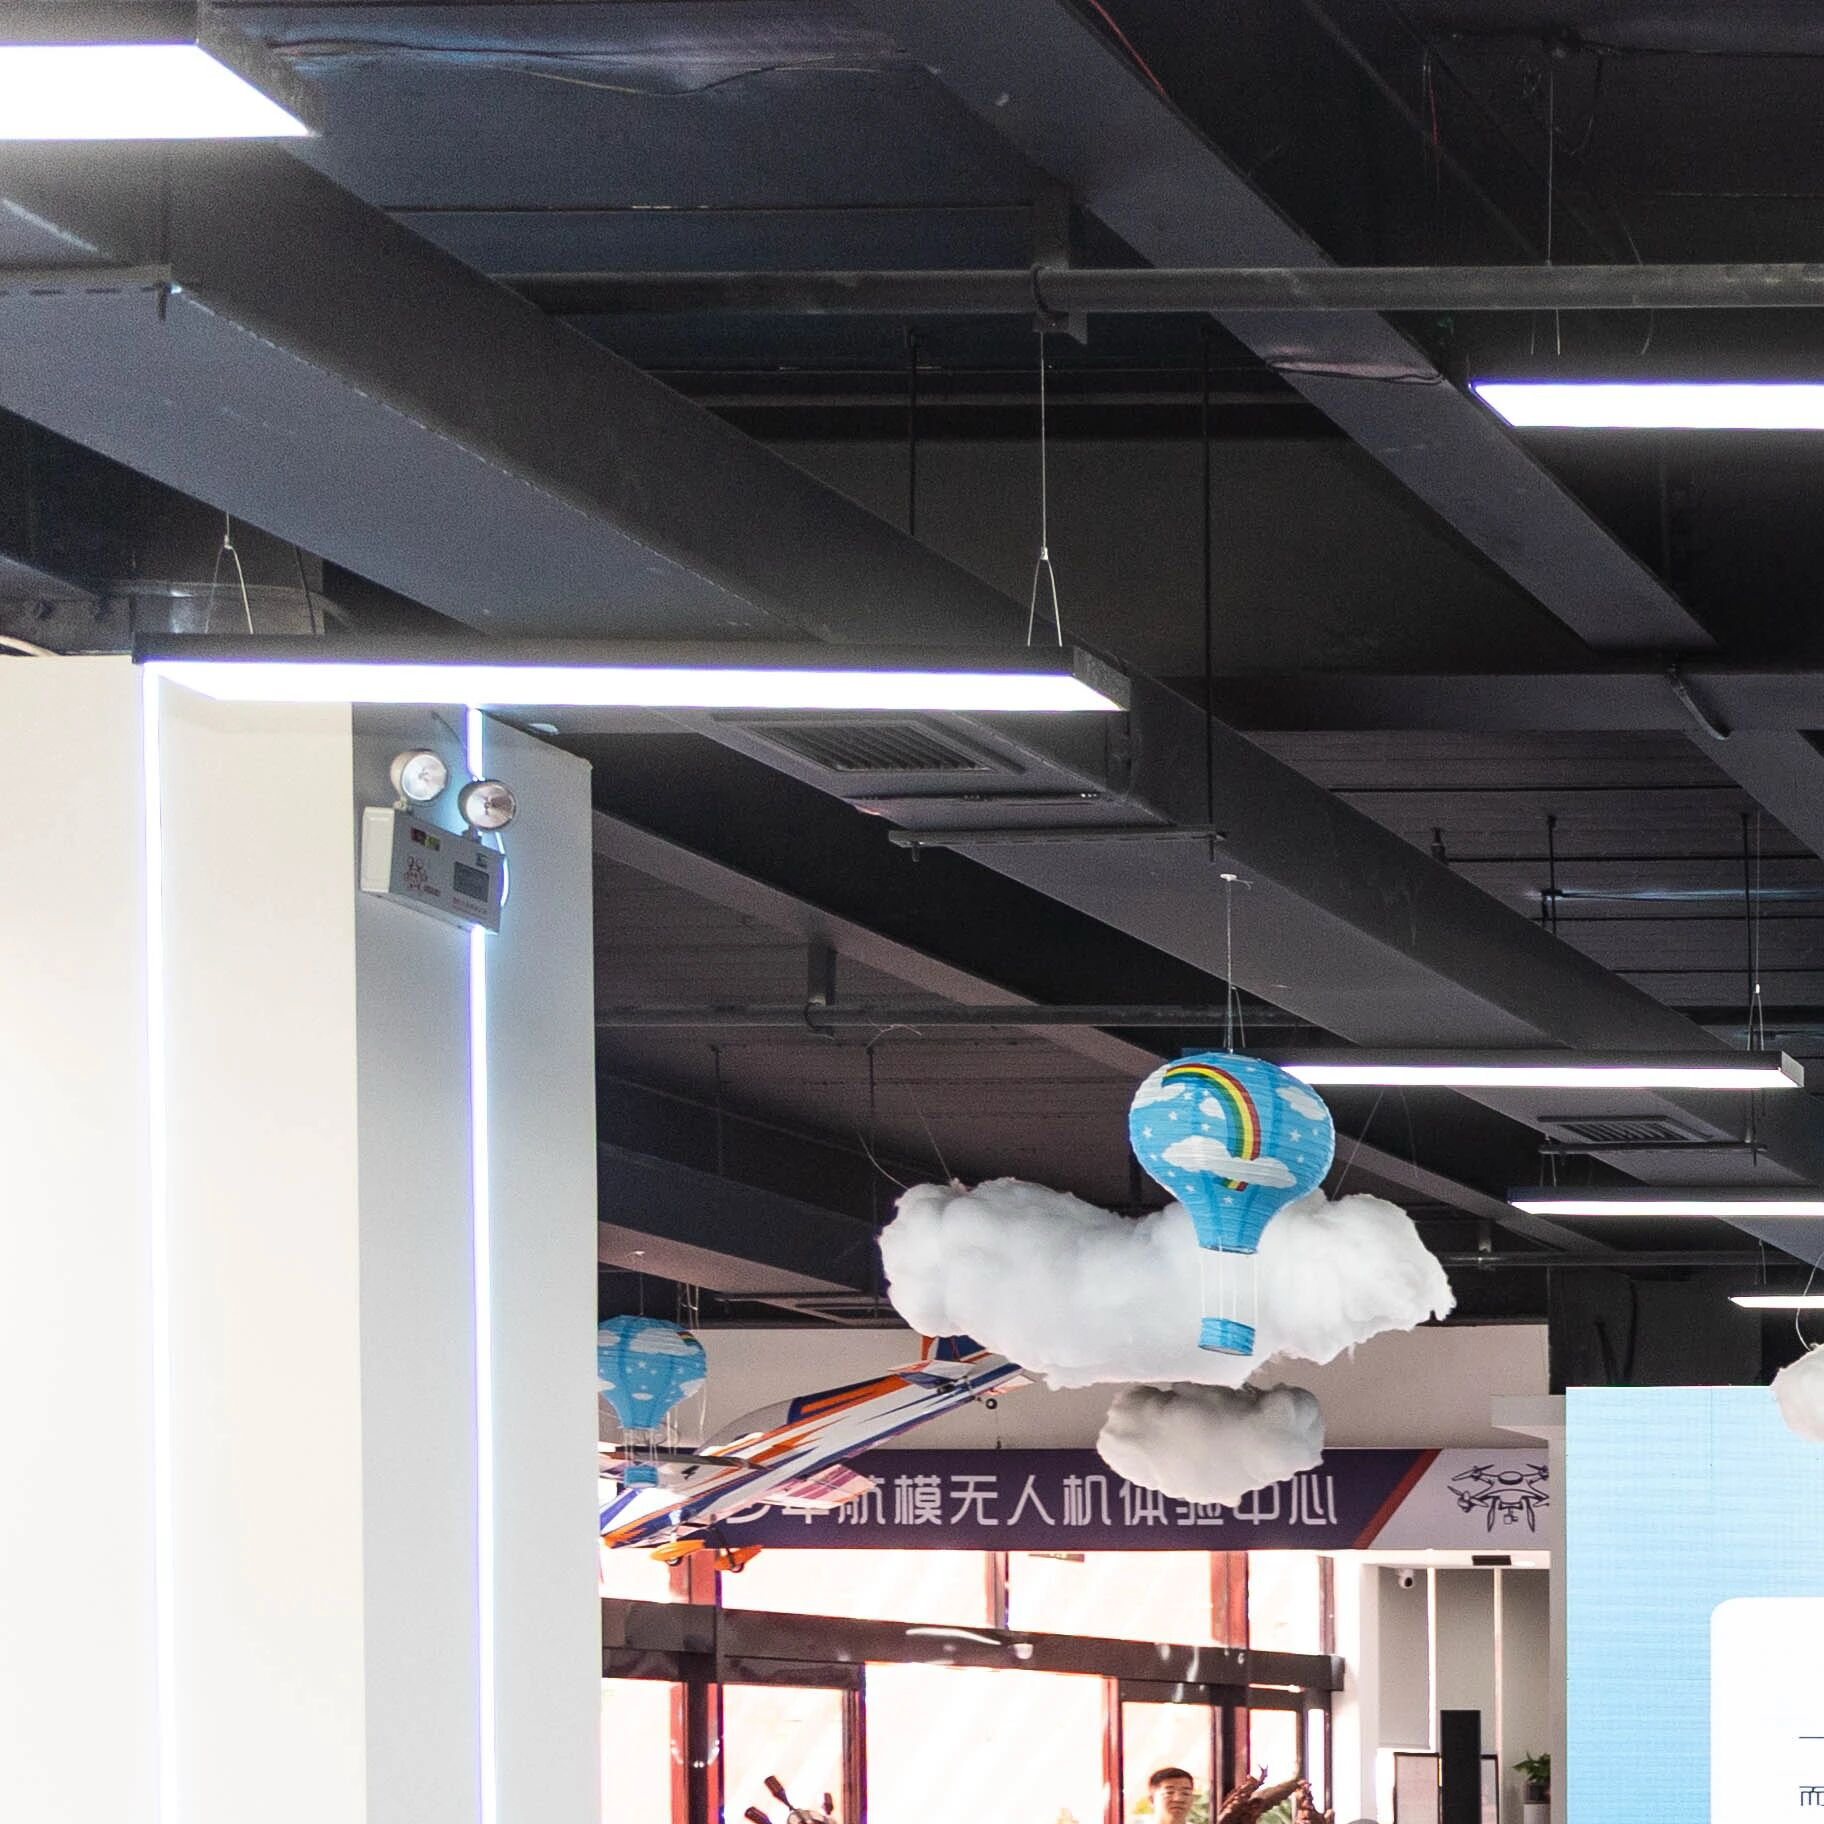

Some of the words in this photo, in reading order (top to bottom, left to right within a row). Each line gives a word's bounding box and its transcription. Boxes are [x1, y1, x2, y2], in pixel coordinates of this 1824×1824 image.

[726, 1474, 1338, 1525] 航模无人机体中心
